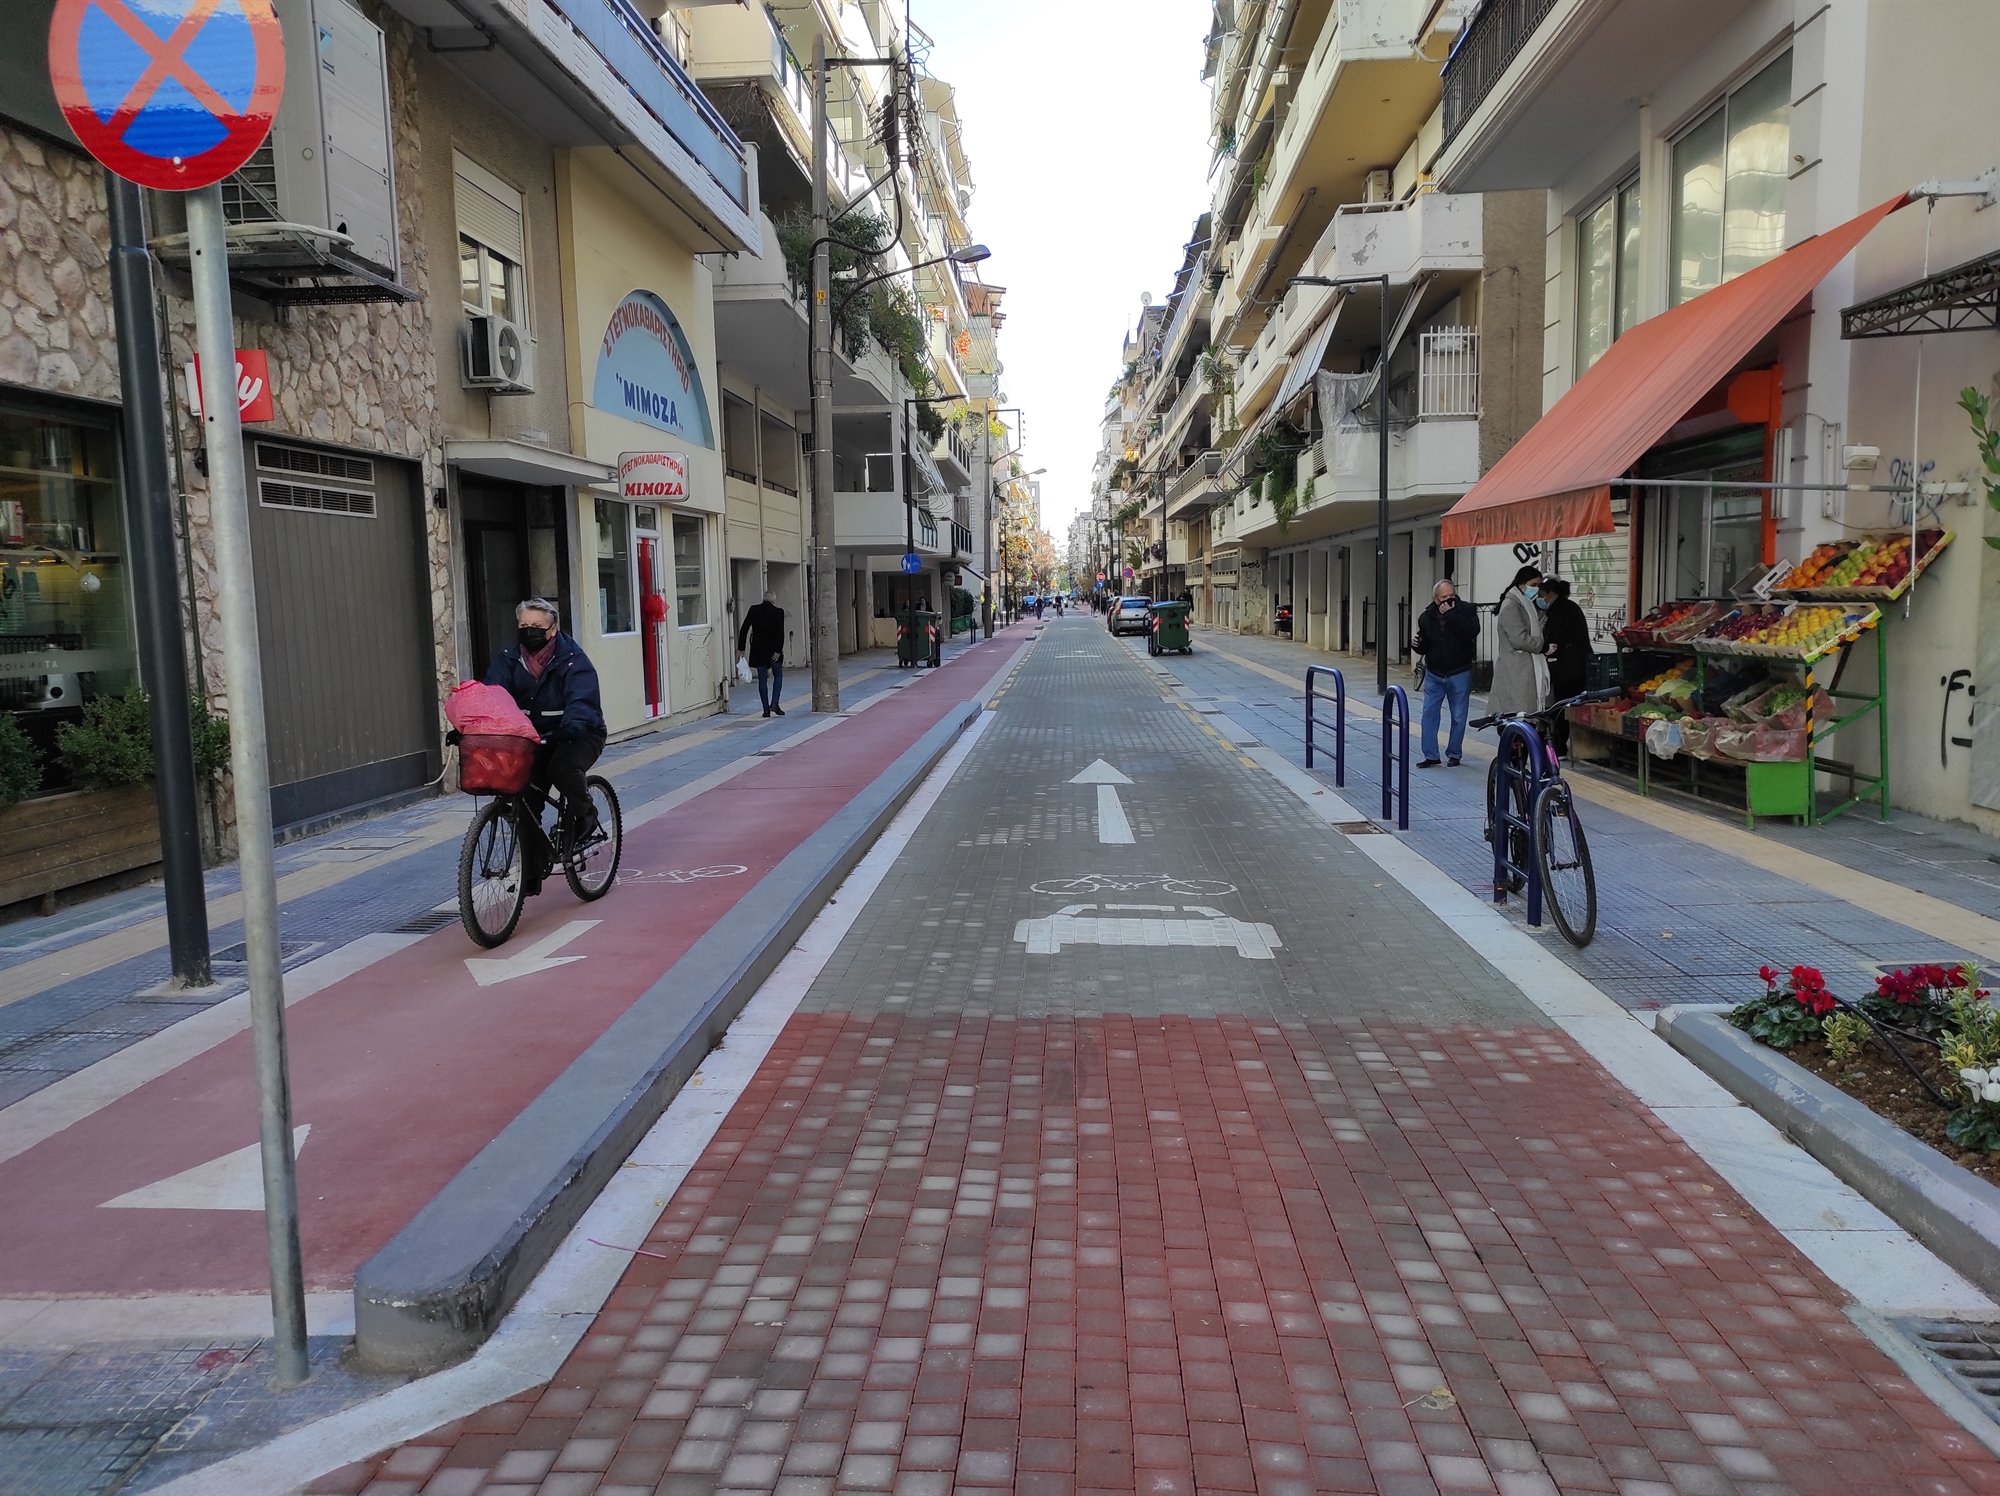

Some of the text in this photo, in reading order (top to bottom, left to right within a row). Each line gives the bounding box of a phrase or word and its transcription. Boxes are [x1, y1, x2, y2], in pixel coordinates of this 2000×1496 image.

[603, 302, 689, 394] ΣΤΕΓΝΟΚΑΘΑΡΙΣΤΗΡΙΟ
[235, 362, 263, 411] ly
[624, 482, 684, 496] ΜΙΜΟΖΑ
[1825, 637, 1841, 650] fresh
